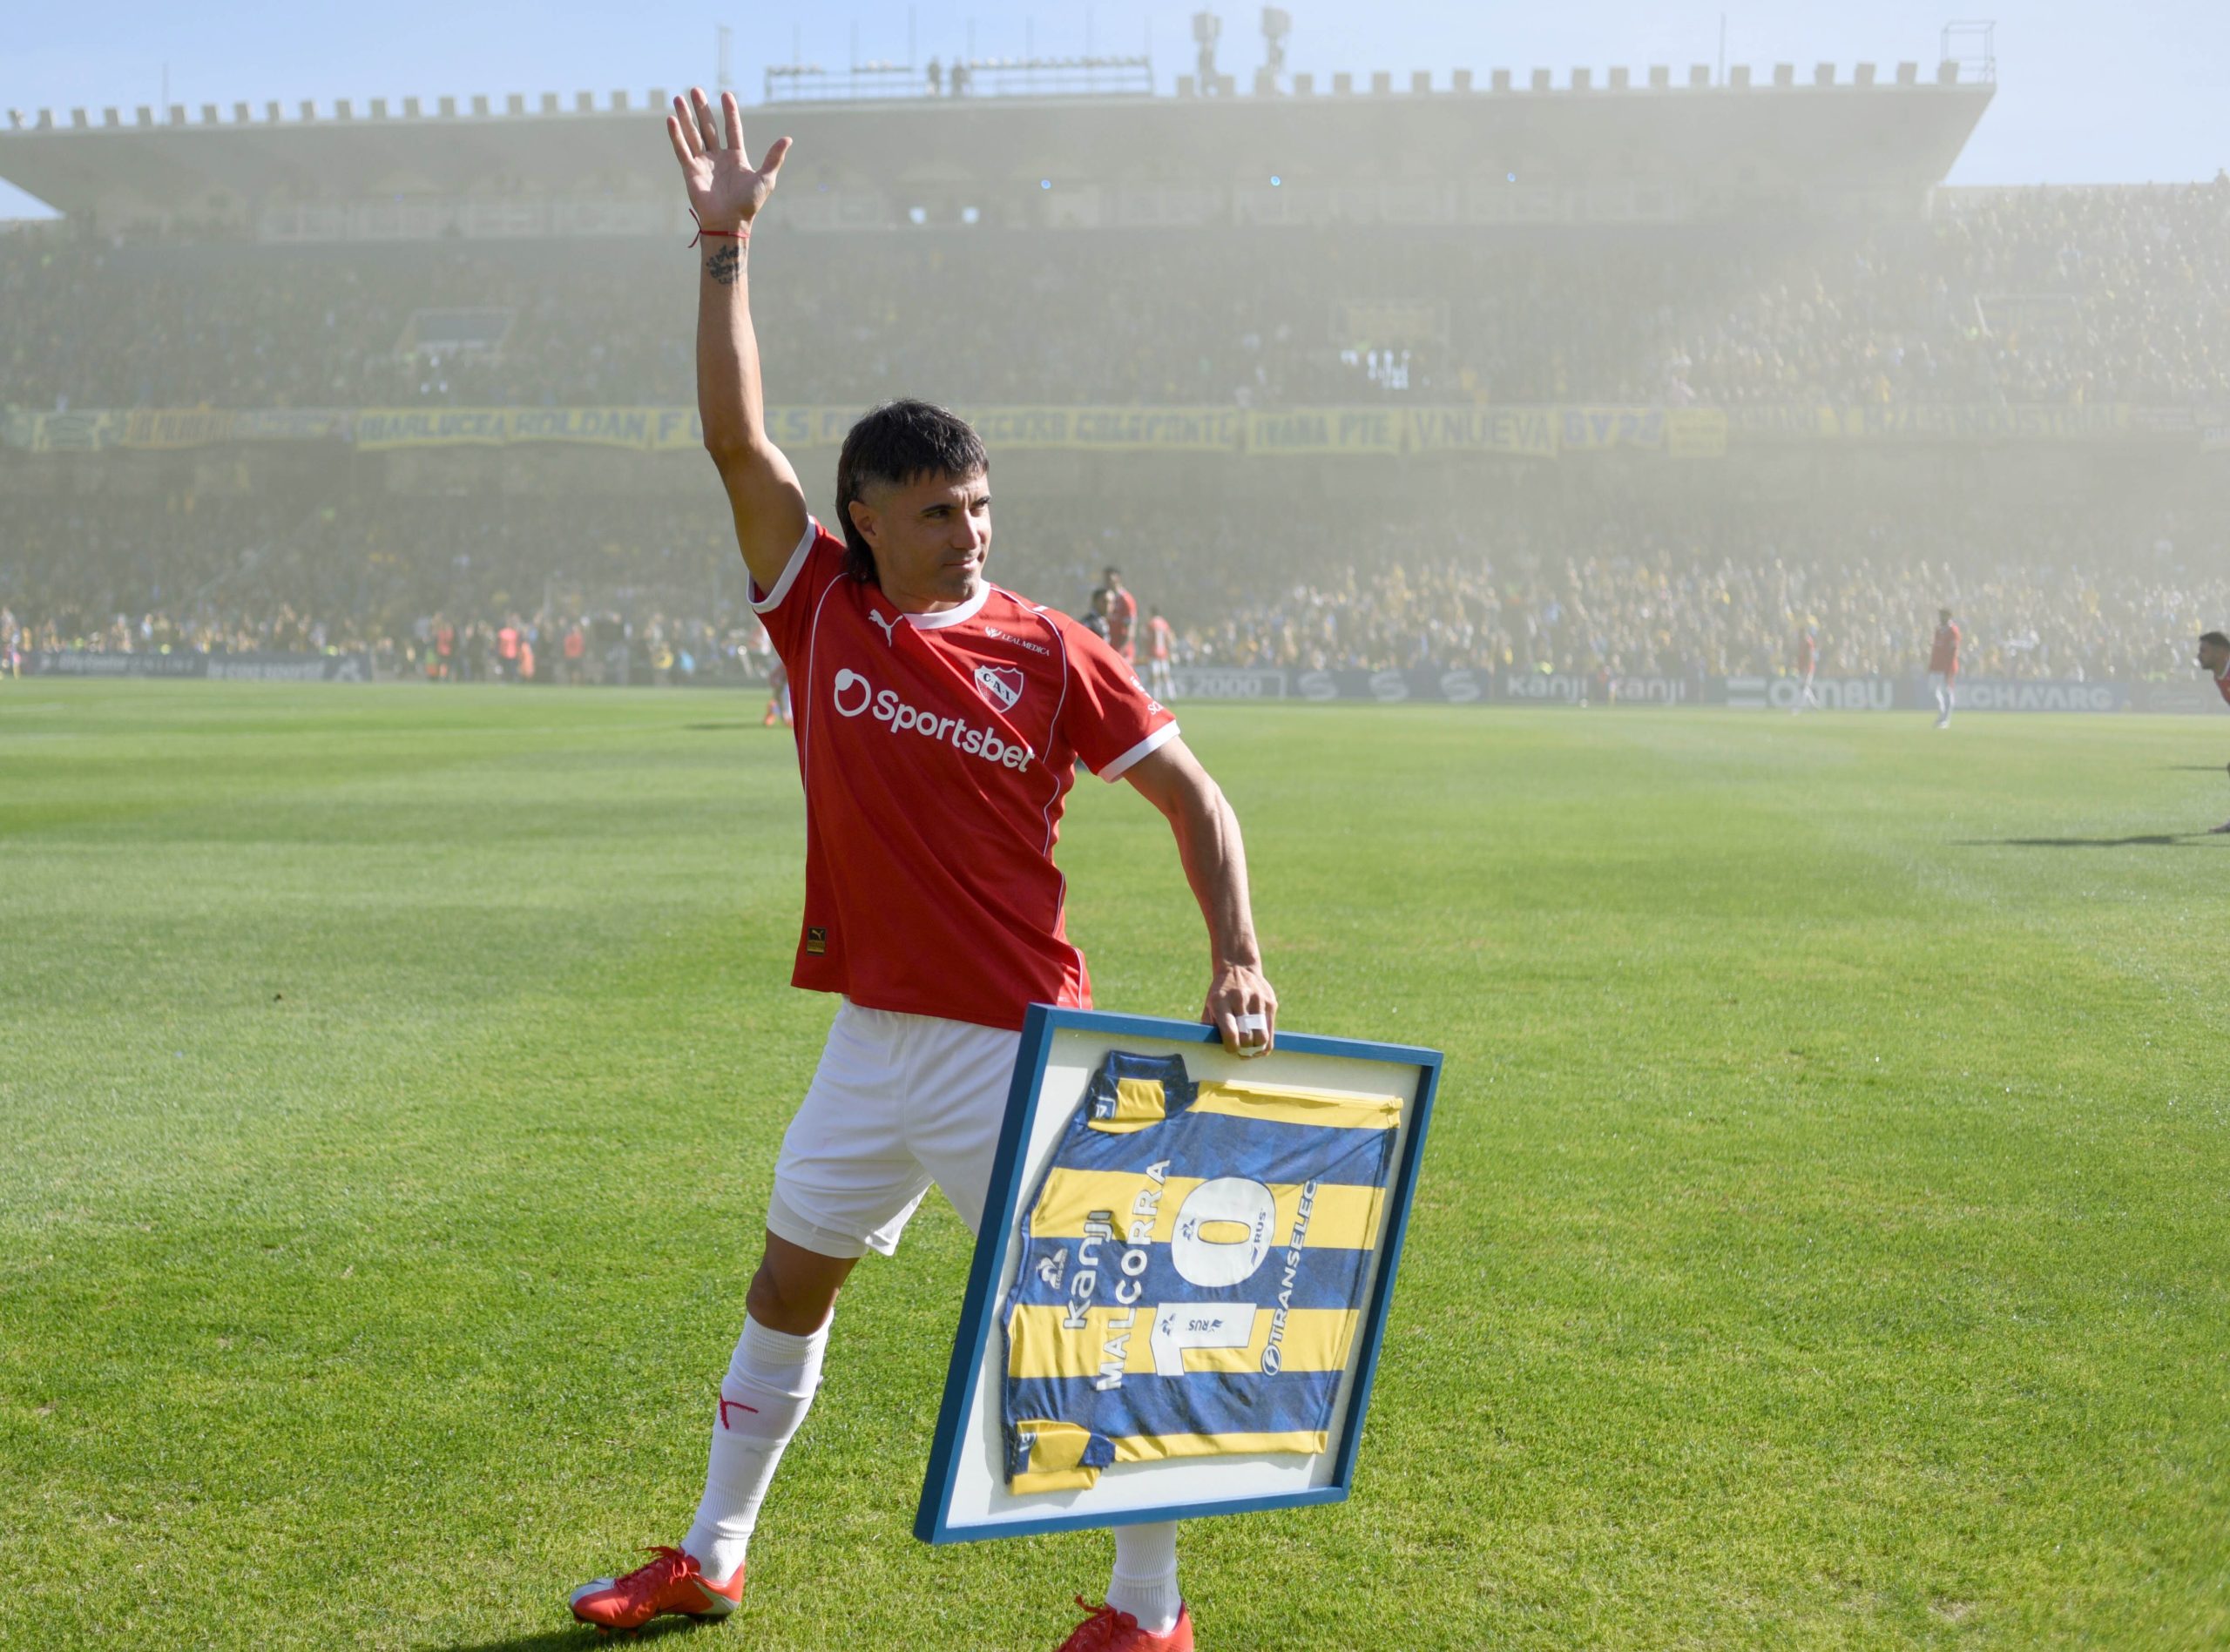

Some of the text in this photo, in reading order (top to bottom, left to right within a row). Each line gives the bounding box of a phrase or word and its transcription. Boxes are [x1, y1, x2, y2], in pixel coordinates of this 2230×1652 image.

[1001, 634, 1020, 646] LEAL
[872, 690, 1035, 772] Sportsbet
[1253, 1210, 1267, 1244] RUS
[1267, 1178, 1317, 1345] TRANSELEC
[1096, 1159, 1171, 1391] MALCORRA
[1150, 1177, 1276, 1376] 10
[1187, 1318, 1210, 1332] RUS
